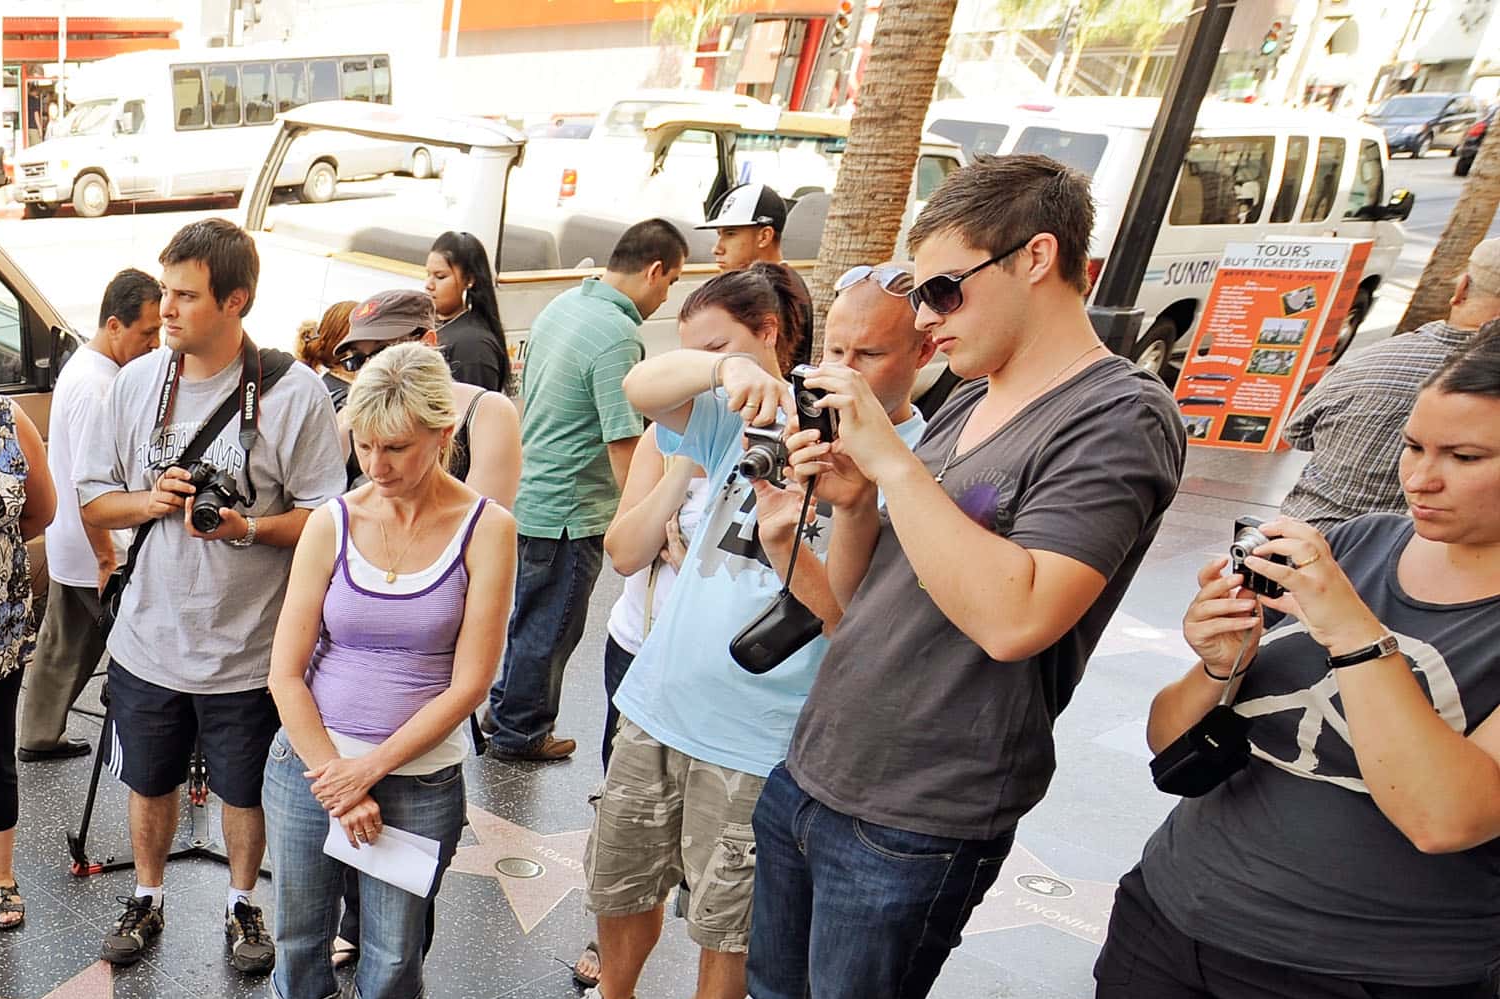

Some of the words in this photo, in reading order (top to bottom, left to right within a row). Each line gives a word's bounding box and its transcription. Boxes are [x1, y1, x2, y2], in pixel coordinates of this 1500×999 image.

[1256, 245, 1311, 257] TOURS
[1223, 257, 1249, 267] BUY
[1252, 258, 1302, 269] TICKETS
[1304, 259, 1339, 270] HERE
[167, 361, 177, 382] EOS
[158, 383, 171, 422] DIGITAL
[245, 381, 256, 420] Canon
